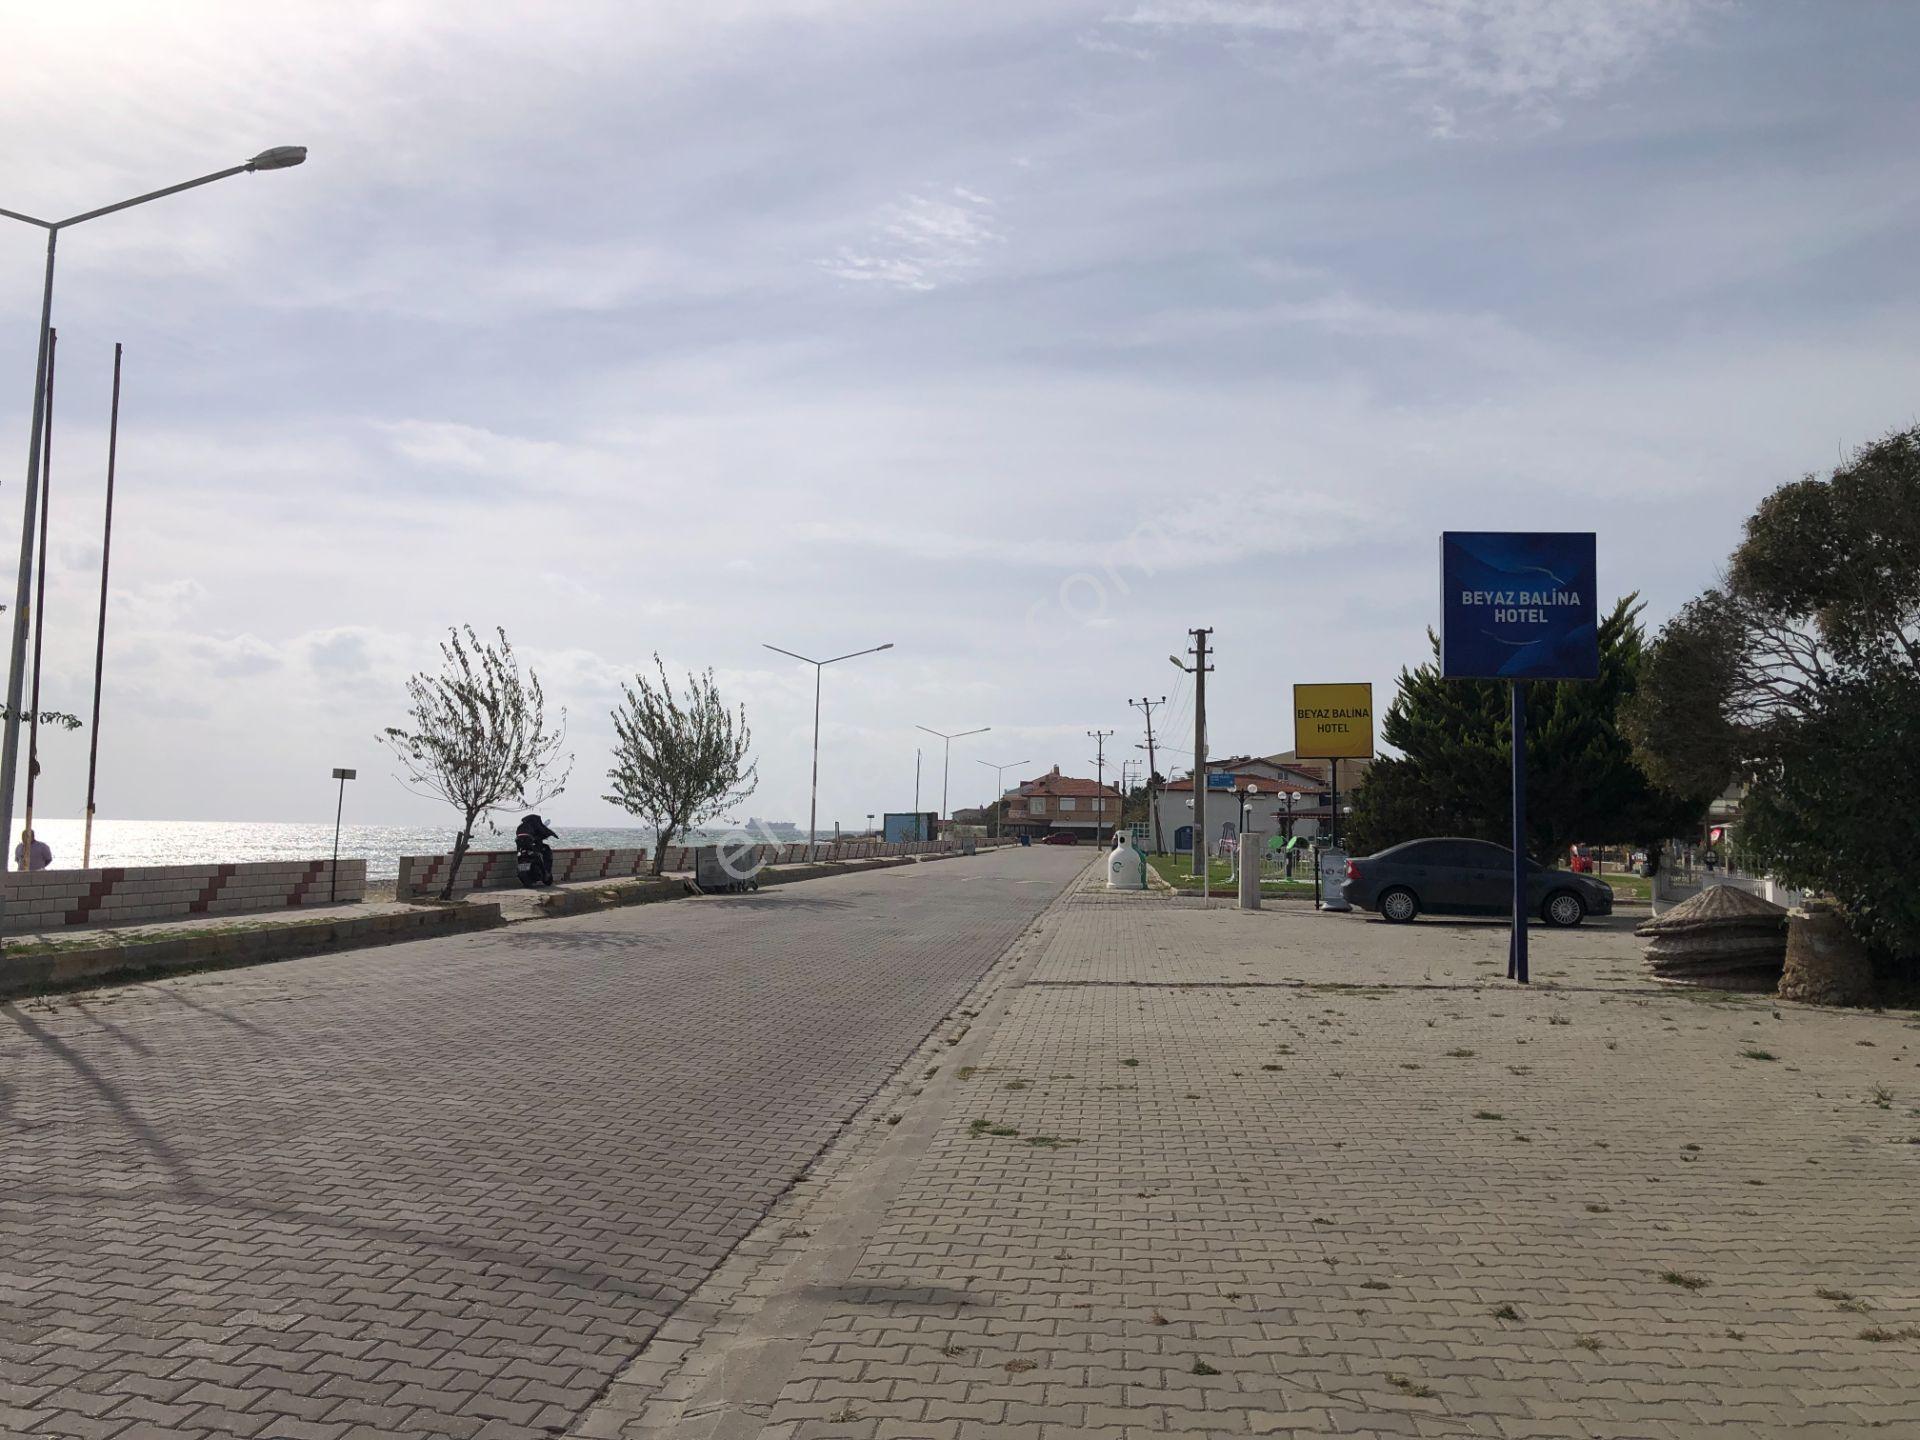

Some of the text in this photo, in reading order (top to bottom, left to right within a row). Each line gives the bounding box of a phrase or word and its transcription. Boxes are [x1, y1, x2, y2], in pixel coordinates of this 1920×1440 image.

[1462, 588, 1581, 605] BEYAZ BALİNA
[1494, 609, 1548, 623] HOTEL
[1297, 709, 1330, 719] BEYAZ
[1317, 723, 1350, 733] HOTEL
